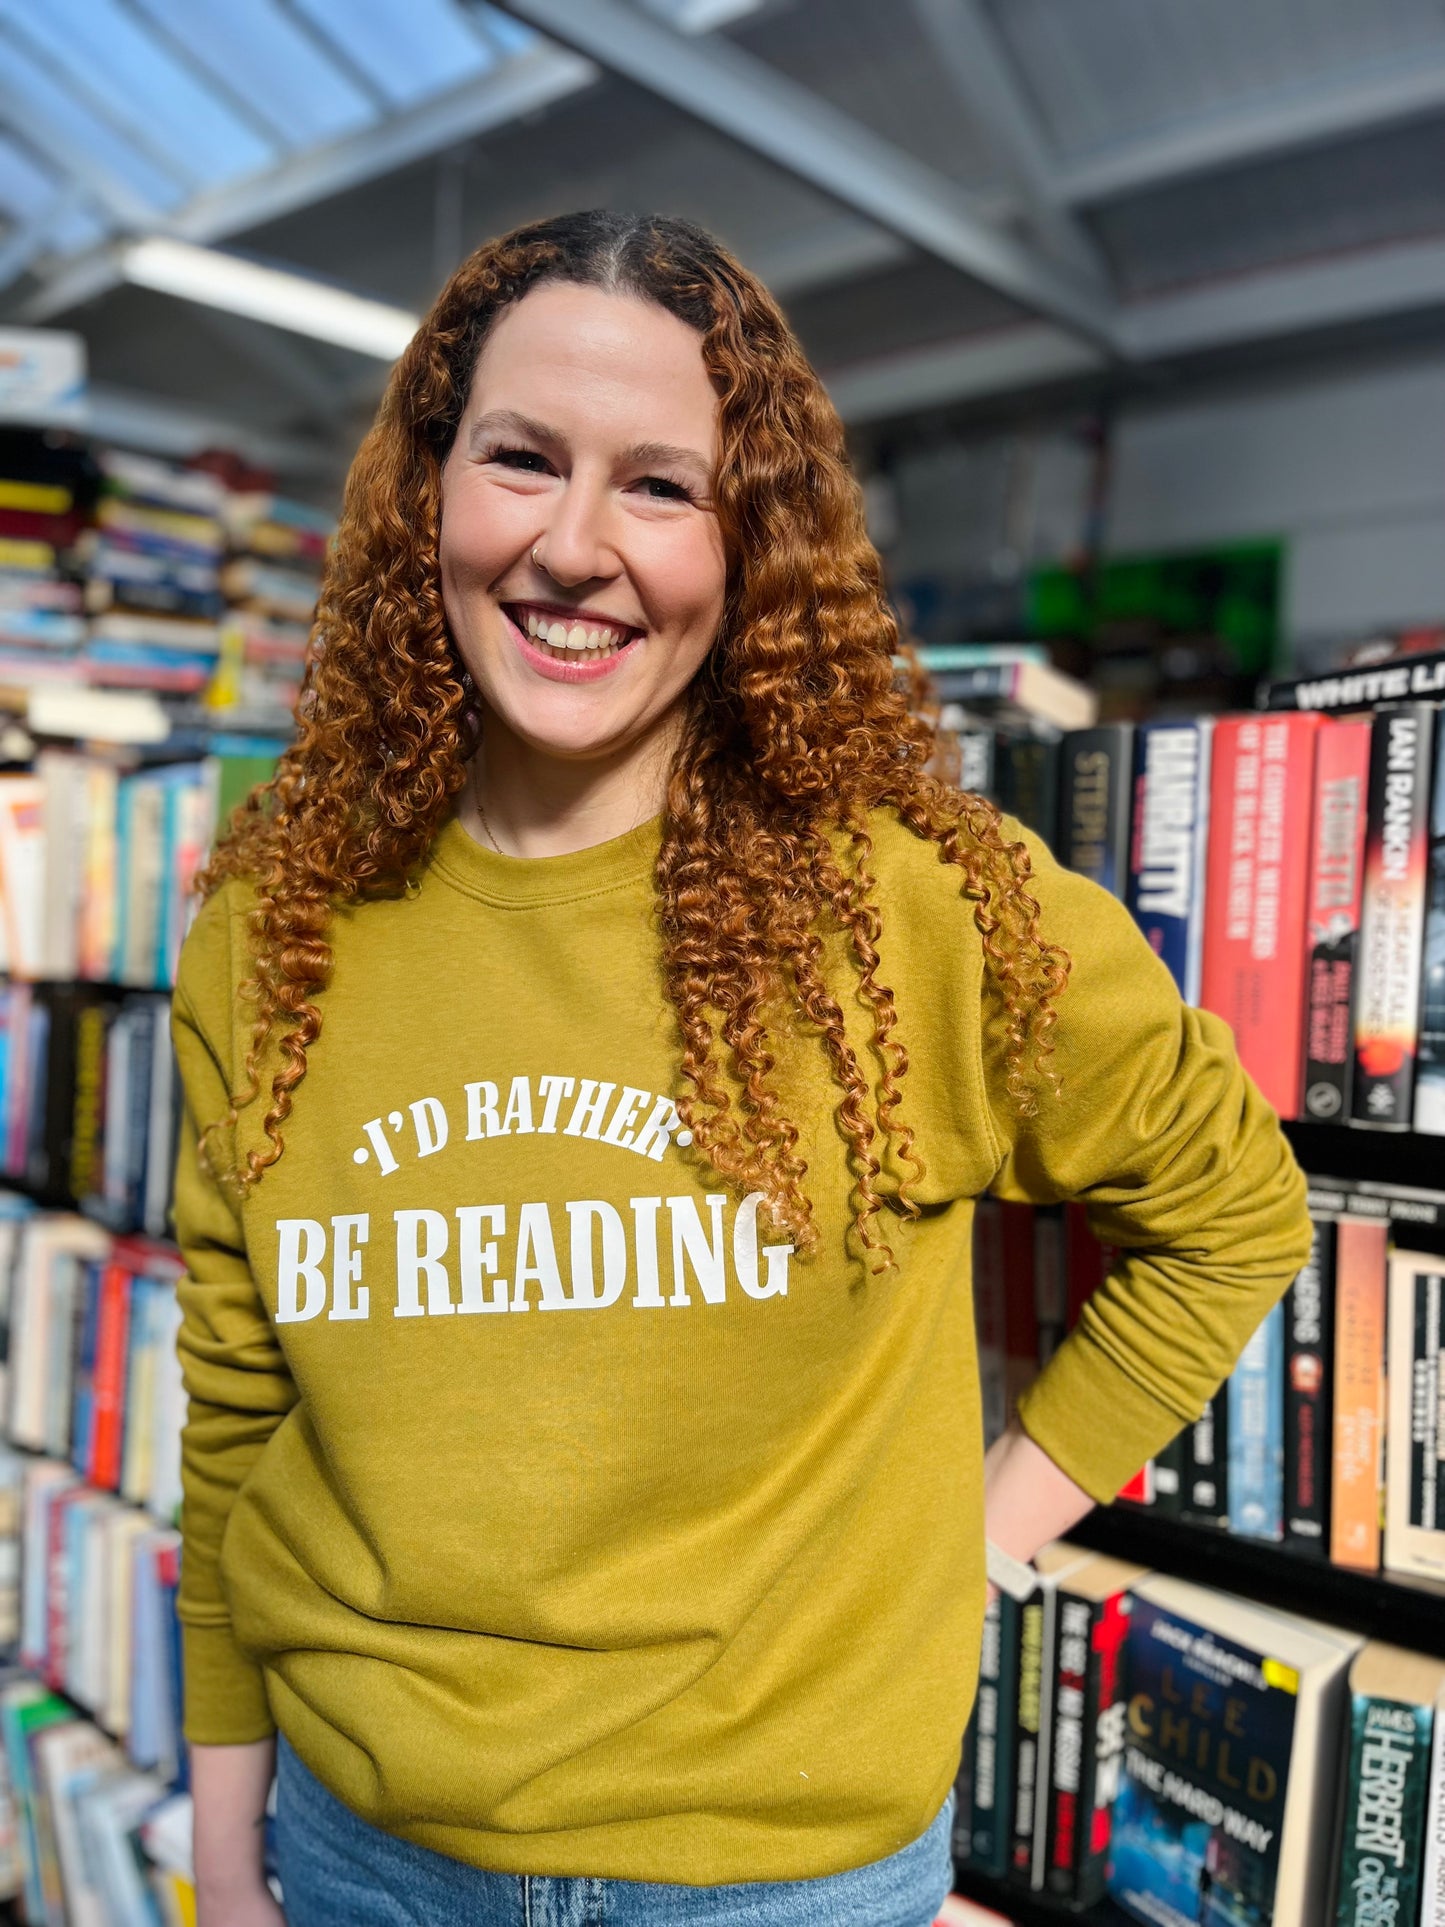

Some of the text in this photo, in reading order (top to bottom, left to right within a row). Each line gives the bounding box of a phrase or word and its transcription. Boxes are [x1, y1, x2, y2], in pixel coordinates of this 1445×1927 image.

[1296, 667, 1410, 710] WHITE
[1263, 722, 1288, 761] THE
[1137, 728, 1197, 919] HANRATTY
[1226, 722, 1260, 939] OF THE BLACK MUSEUM
[1257, 763, 1286, 862] COMPLETE
[1317, 776, 1360, 910] VENDETTA
[1382, 718, 1418, 880] IAN RANKIN
[1368, 882, 1393, 1035] OF HEADSTONES
[1394, 913, 1410, 975] HEART
[1389, 981, 1408, 1026] FULL
[464, 1075, 679, 1161] RATHER
[275, 1191, 794, 1323] BE READING
[1127, 1693, 1278, 1802] CHILD
[1160, 1665, 1248, 1738] LEE
[1367, 1706, 1416, 1733] JAMES
[1126, 1746, 1166, 1793] THE
[1162, 1771, 1225, 1826] HARD
[1223, 1805, 1274, 1854] WAY
[1354, 1726, 1415, 1869] HERBERT
[1381, 1875, 1399, 1896] THE
